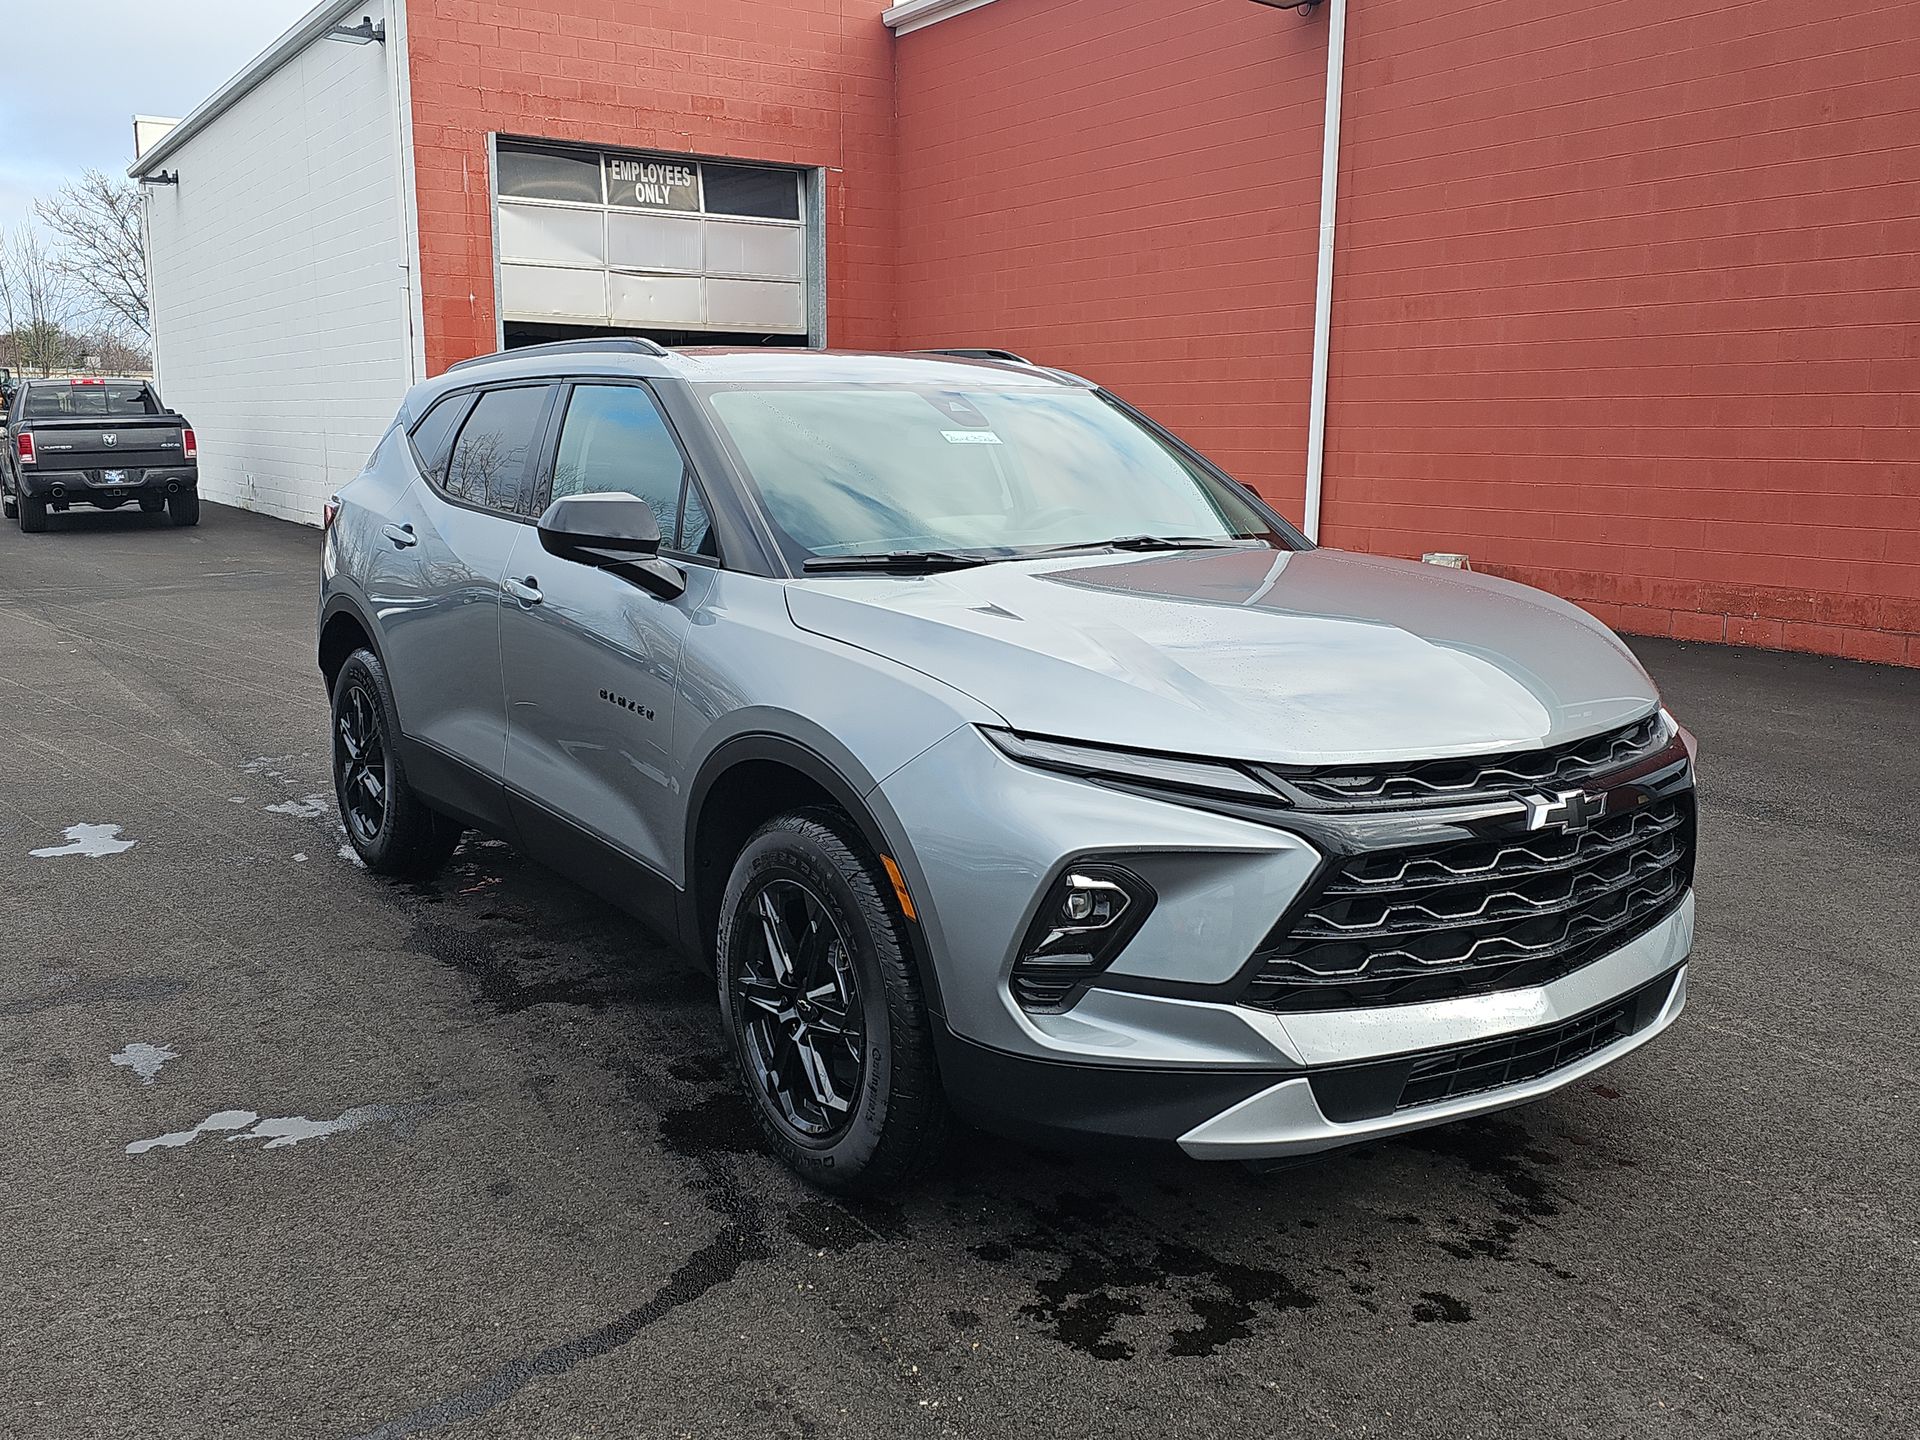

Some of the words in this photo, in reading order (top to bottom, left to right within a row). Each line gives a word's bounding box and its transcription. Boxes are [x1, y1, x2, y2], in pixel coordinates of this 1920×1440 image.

[611, 159, 691, 187] EMPLOYEES
[635, 182, 671, 205] ONLY
[599, 689, 655, 722] BLAZER
